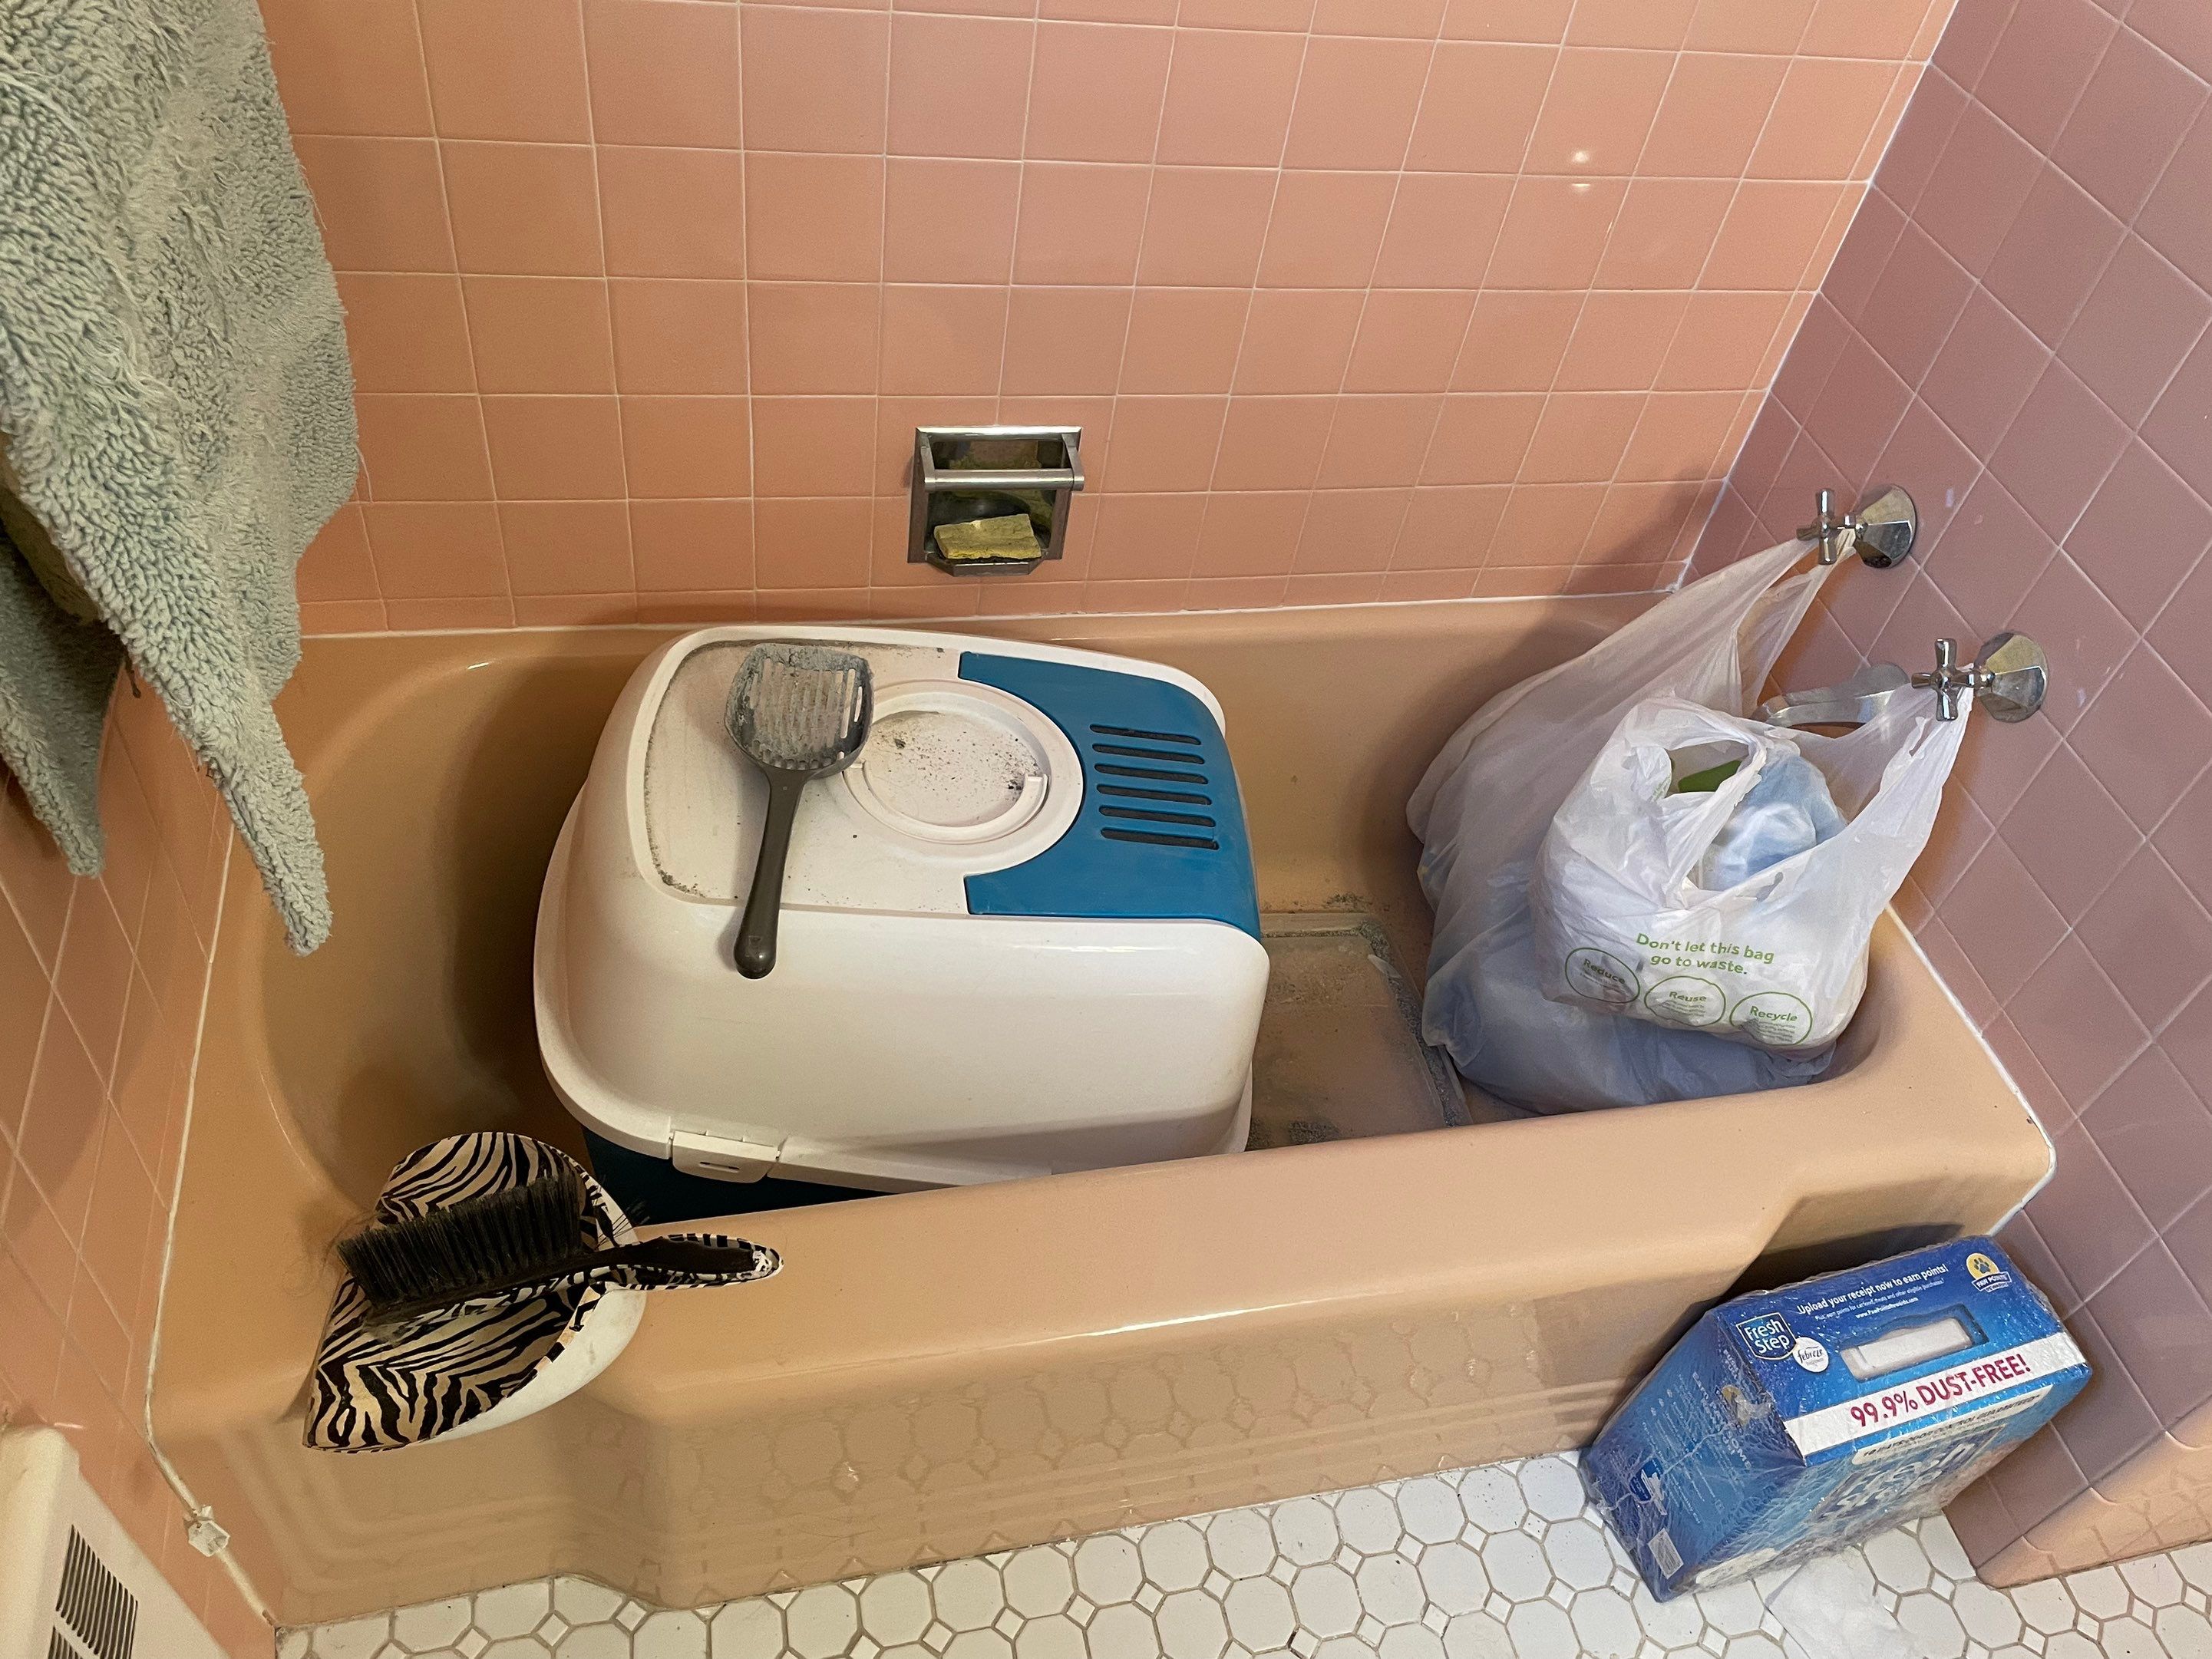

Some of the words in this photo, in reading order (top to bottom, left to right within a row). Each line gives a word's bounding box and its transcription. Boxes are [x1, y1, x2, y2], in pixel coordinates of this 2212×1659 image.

[1636, 932, 1681, 952] Don't
[1685, 942, 1705, 952] let
[1710, 942, 1740, 955] this
[1743, 945, 1775, 965] bag
[1583, 958, 1626, 985] Reduce
[1650, 955, 1672, 965] go
[1676, 956, 1692, 967] to
[1697, 959, 1748, 975] waste.
[1669, 991, 1707, 1002] Reuse
[1750, 1005, 1799, 1022] Recycle
[1797, 1298, 1828, 1315] Upload
[1828, 1295, 1847, 1308] your
[1847, 1285, 1876, 1301] receipt
[1875, 1281, 1893, 1292] now
[1893, 1278, 1903, 1287] to
[1903, 1274, 1921, 1284] earn
[1921, 1264, 1949, 1281] points!
[1744, 1319, 1784, 1341] Fresh
[1755, 1334, 1790, 1354] Step
[1850, 1390, 1918, 1426] 99.9%
[1916, 1354, 2031, 1406] DUST-FREE!
